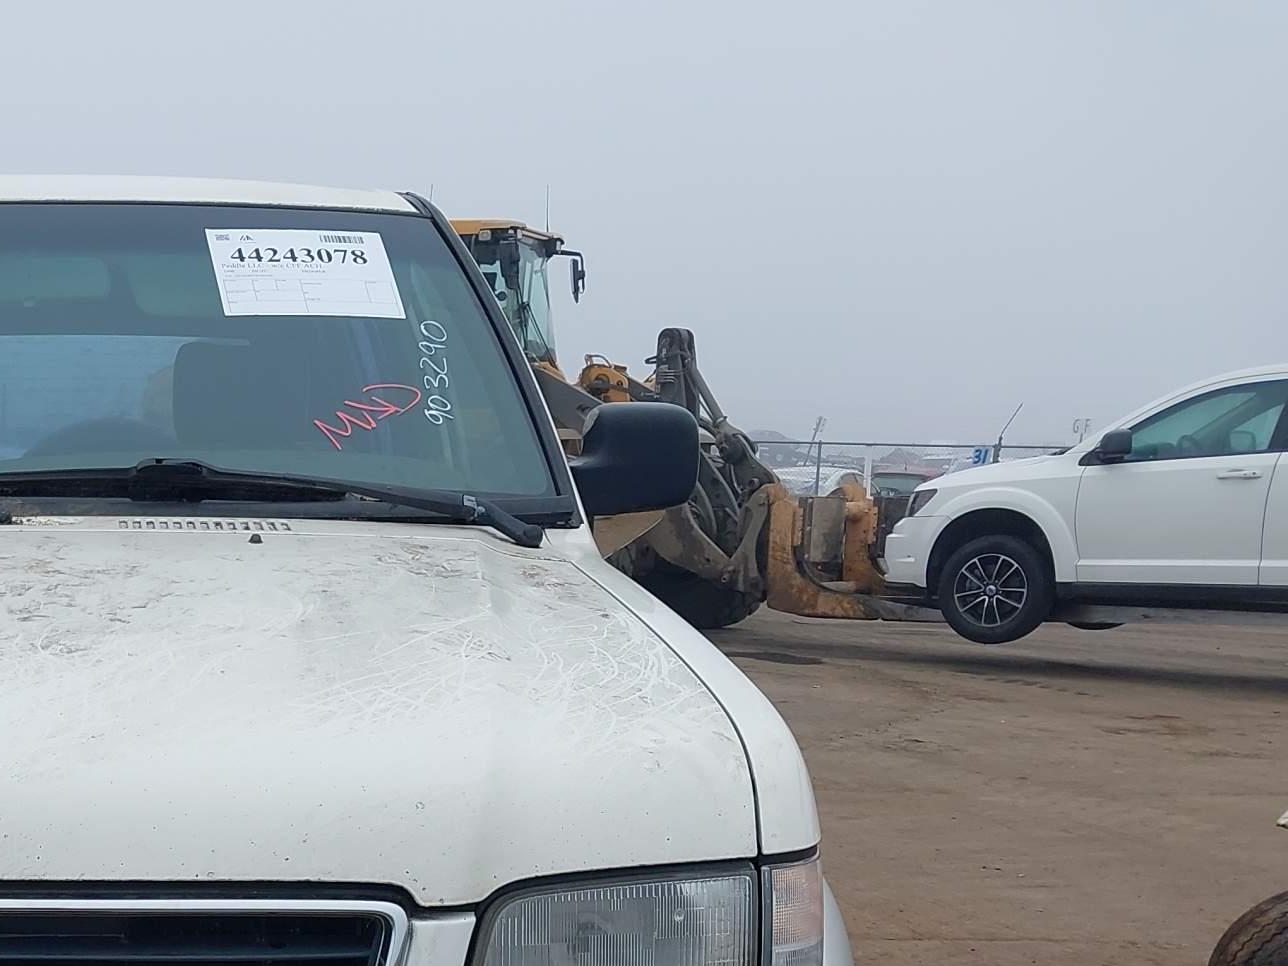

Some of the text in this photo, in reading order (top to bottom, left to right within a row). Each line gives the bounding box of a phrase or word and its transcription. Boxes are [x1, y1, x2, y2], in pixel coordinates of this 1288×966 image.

[230, 247, 368, 265] 44243078
[418, 320, 454, 425] 903290
[972, 448, 989, 464] 31
